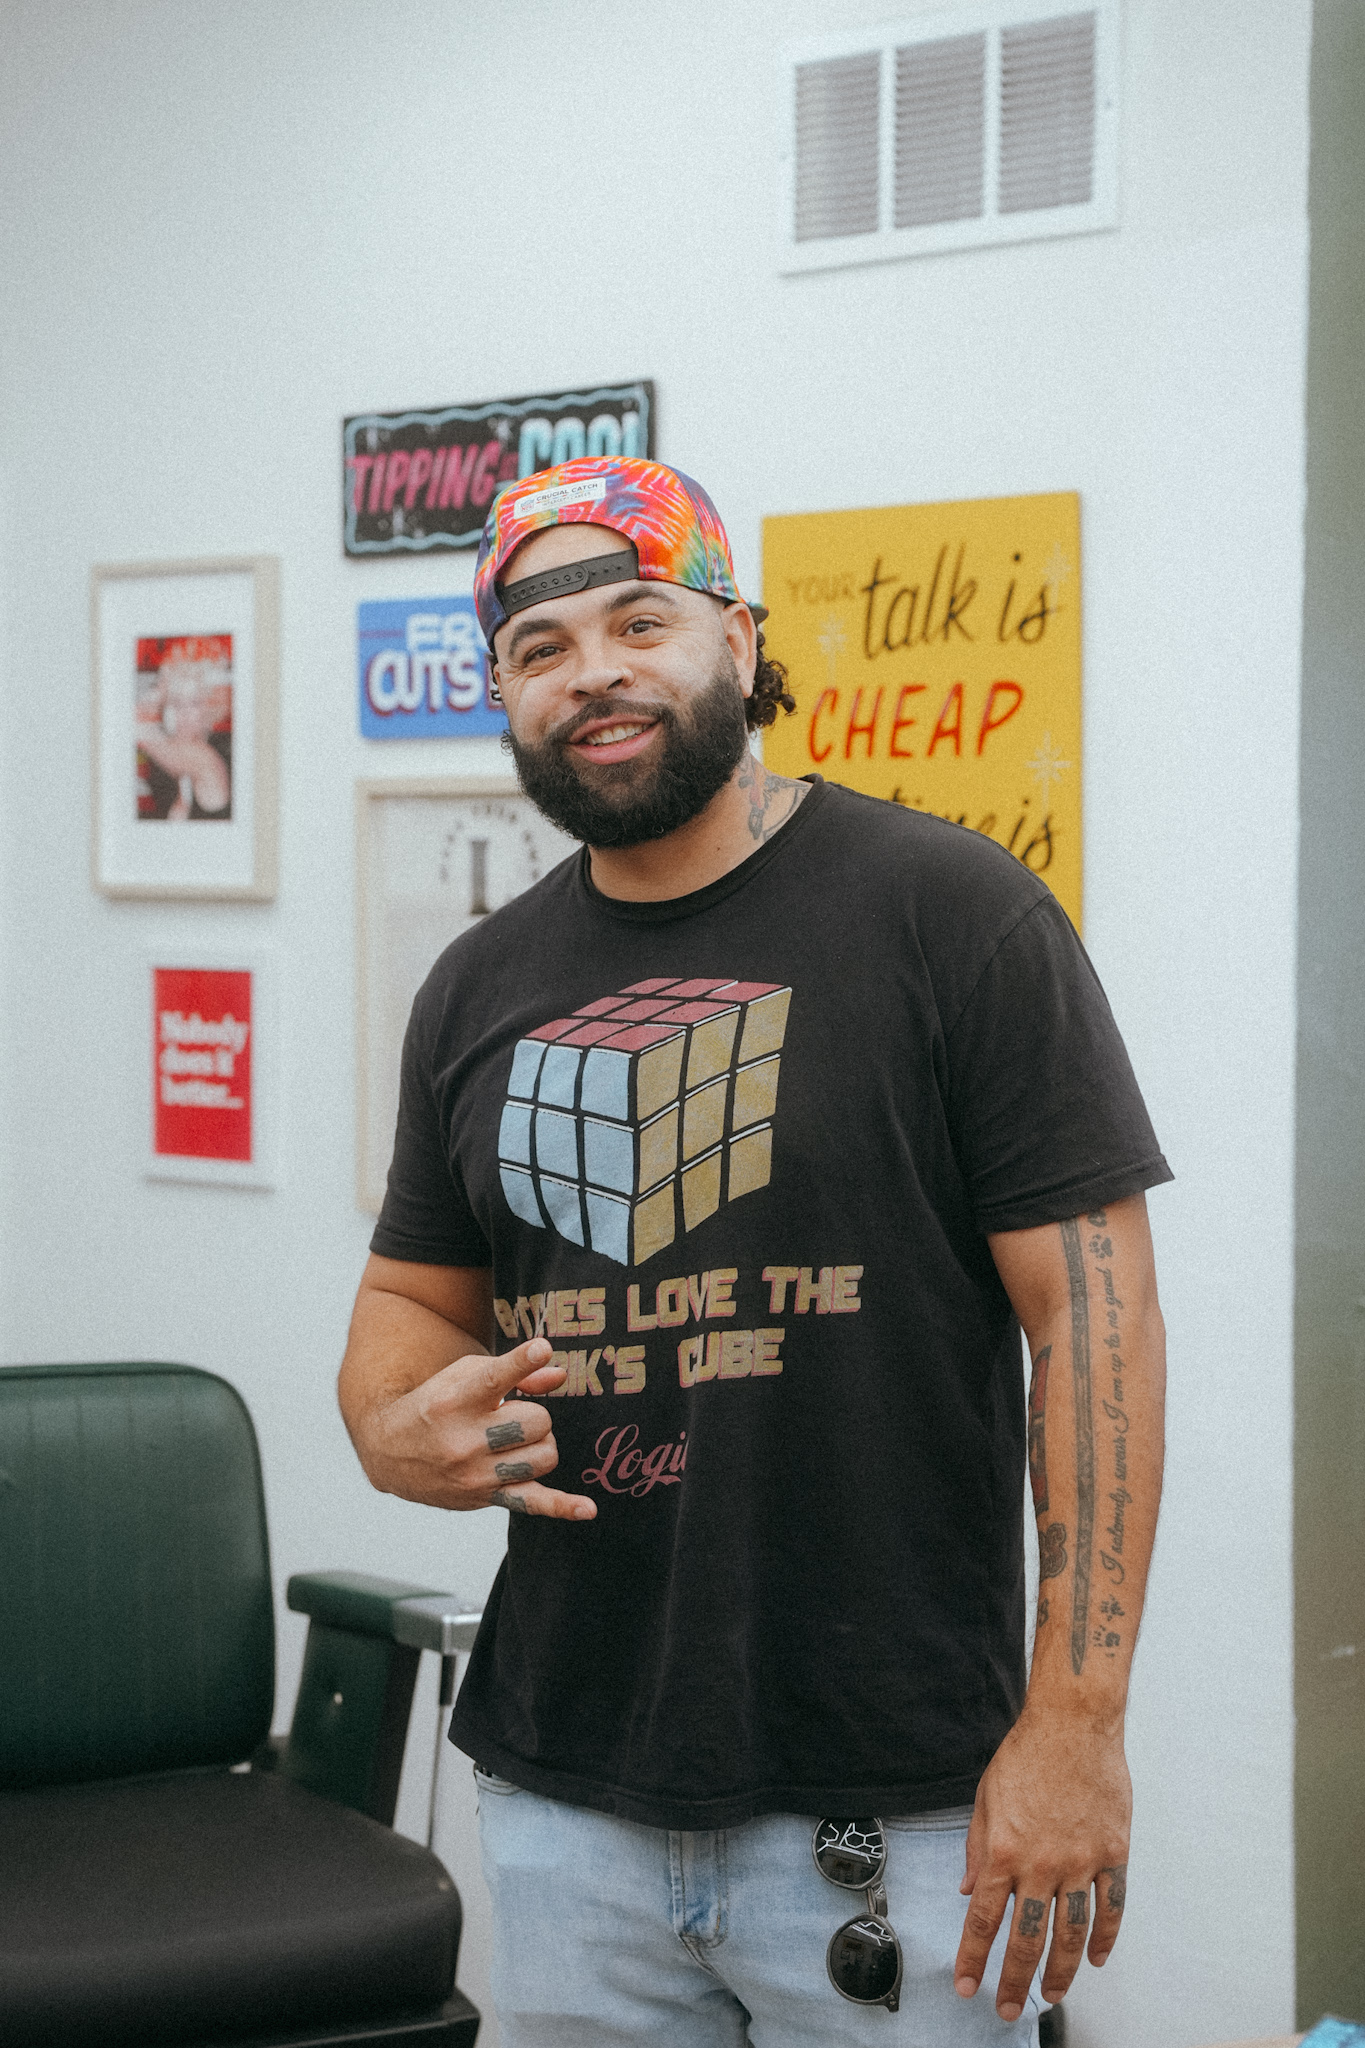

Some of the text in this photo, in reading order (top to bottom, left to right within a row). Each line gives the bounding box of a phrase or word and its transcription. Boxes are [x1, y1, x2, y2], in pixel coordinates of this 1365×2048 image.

[346, 440, 501, 515] TIPPING
[535, 483, 598, 502] CRUCIAL CATCH
[786, 542, 1058, 661] YOUR talk is
[366, 648, 484, 716] CUTS
[808, 681, 1025, 763] CHEAP
[626, 1268, 738, 1333] LOVE
[762, 1265, 863, 1315] THE
[1095, 1265, 1124, 1309] good
[1103, 1332, 1120, 1349] to
[1106, 1308, 1119, 1329] no
[677, 1328, 785, 1389] CUBE
[1111, 1352, 1126, 1373] up
[1113, 1376, 1124, 1402] am
[1113, 1434, 1127, 1481] swear
